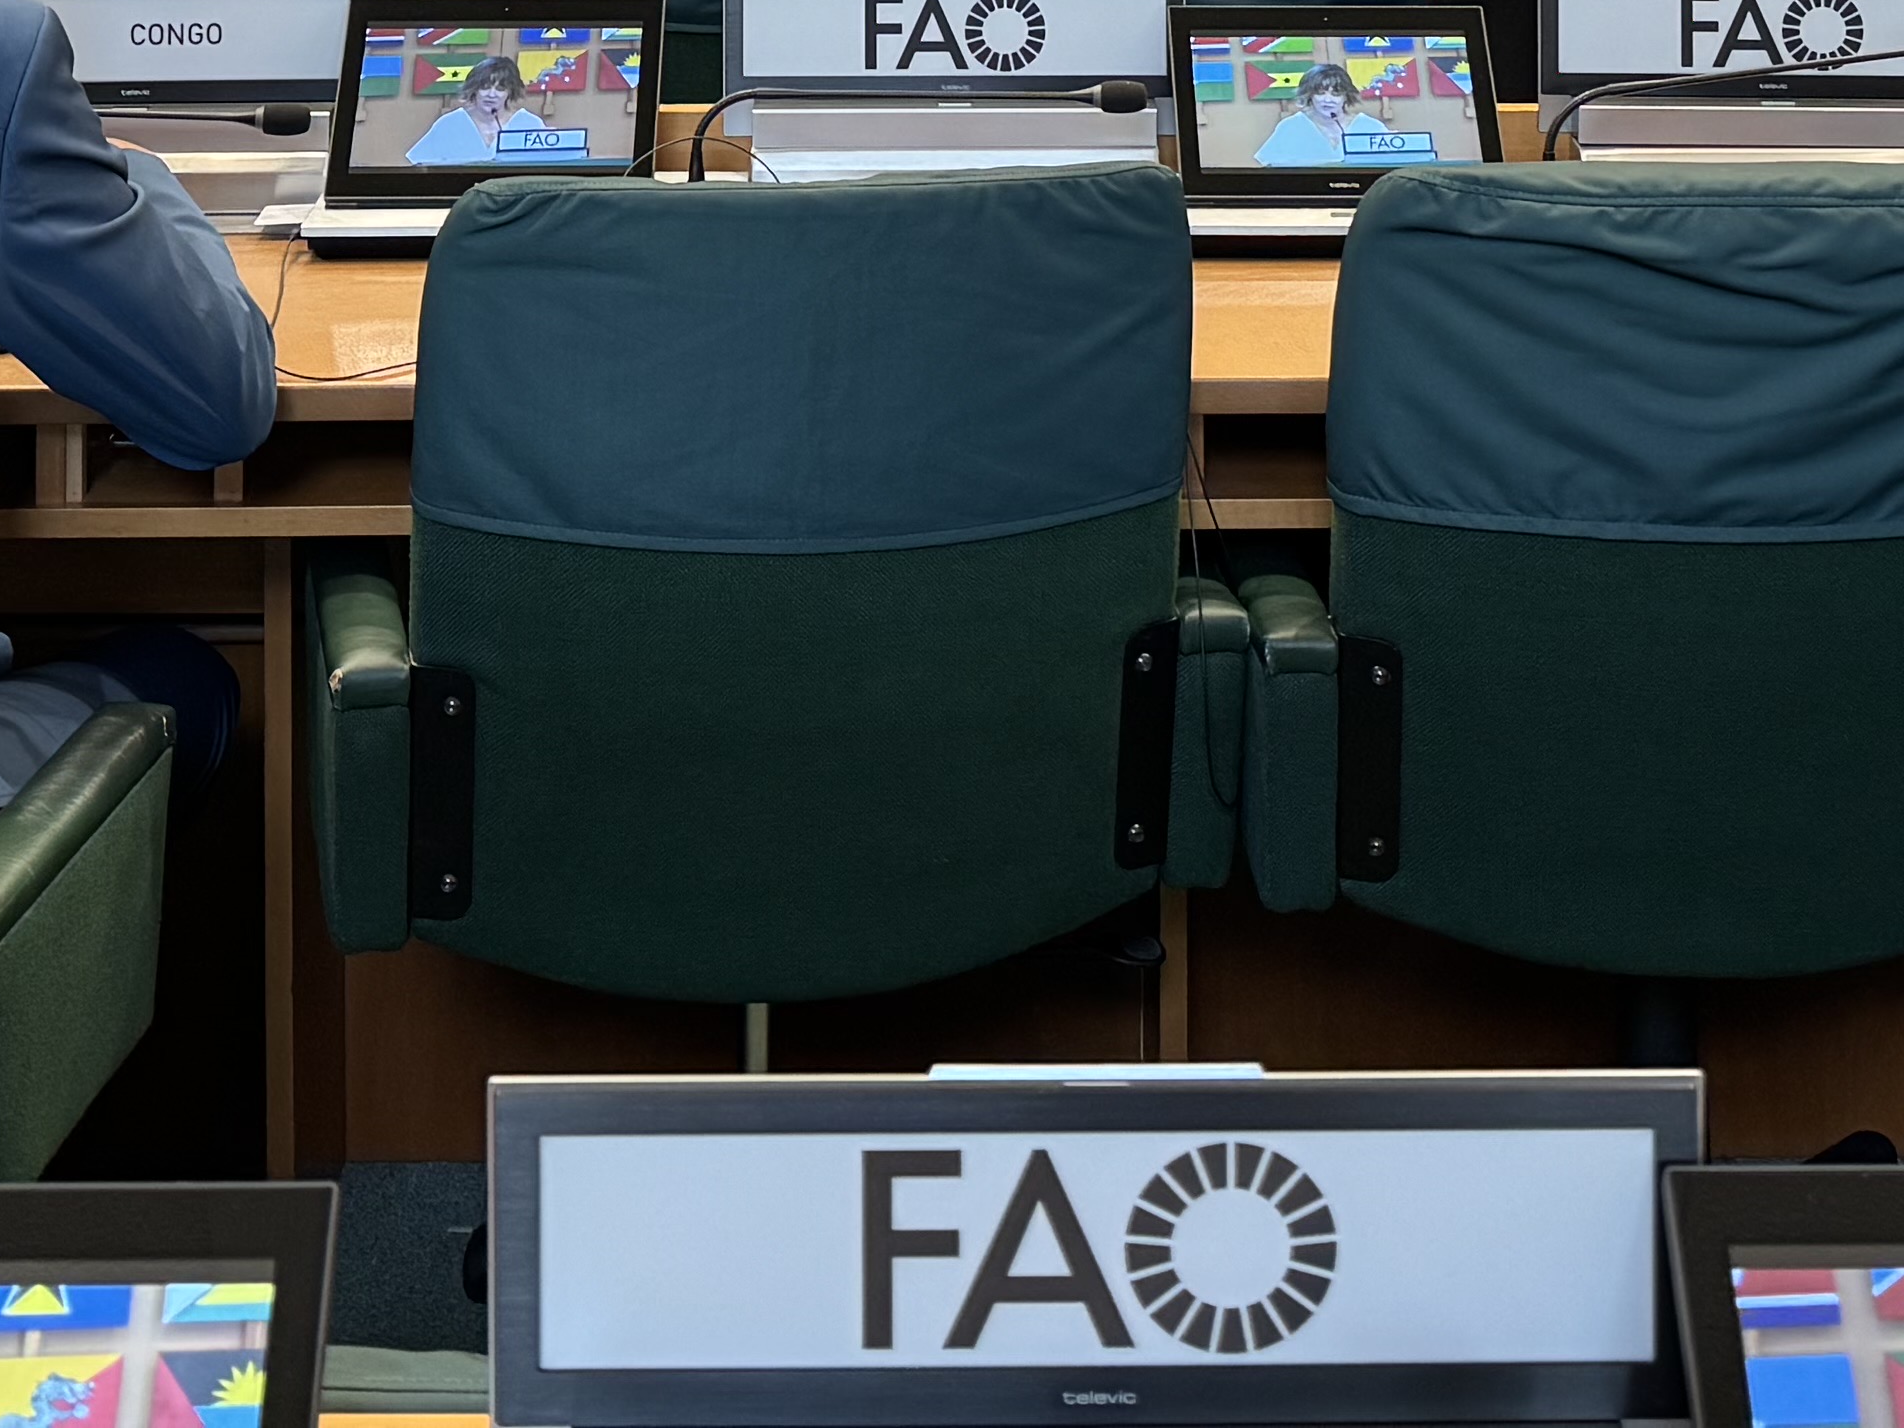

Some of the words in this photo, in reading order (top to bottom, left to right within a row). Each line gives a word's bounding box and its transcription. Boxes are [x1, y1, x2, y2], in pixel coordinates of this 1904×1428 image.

[130, 22, 224, 47] CONGO
[524, 132, 560, 148] FAO
[1369, 136, 1406, 151] FAO
[861, 1141, 1338, 1354] FAO
[1062, 1390, 1137, 1406] televic
